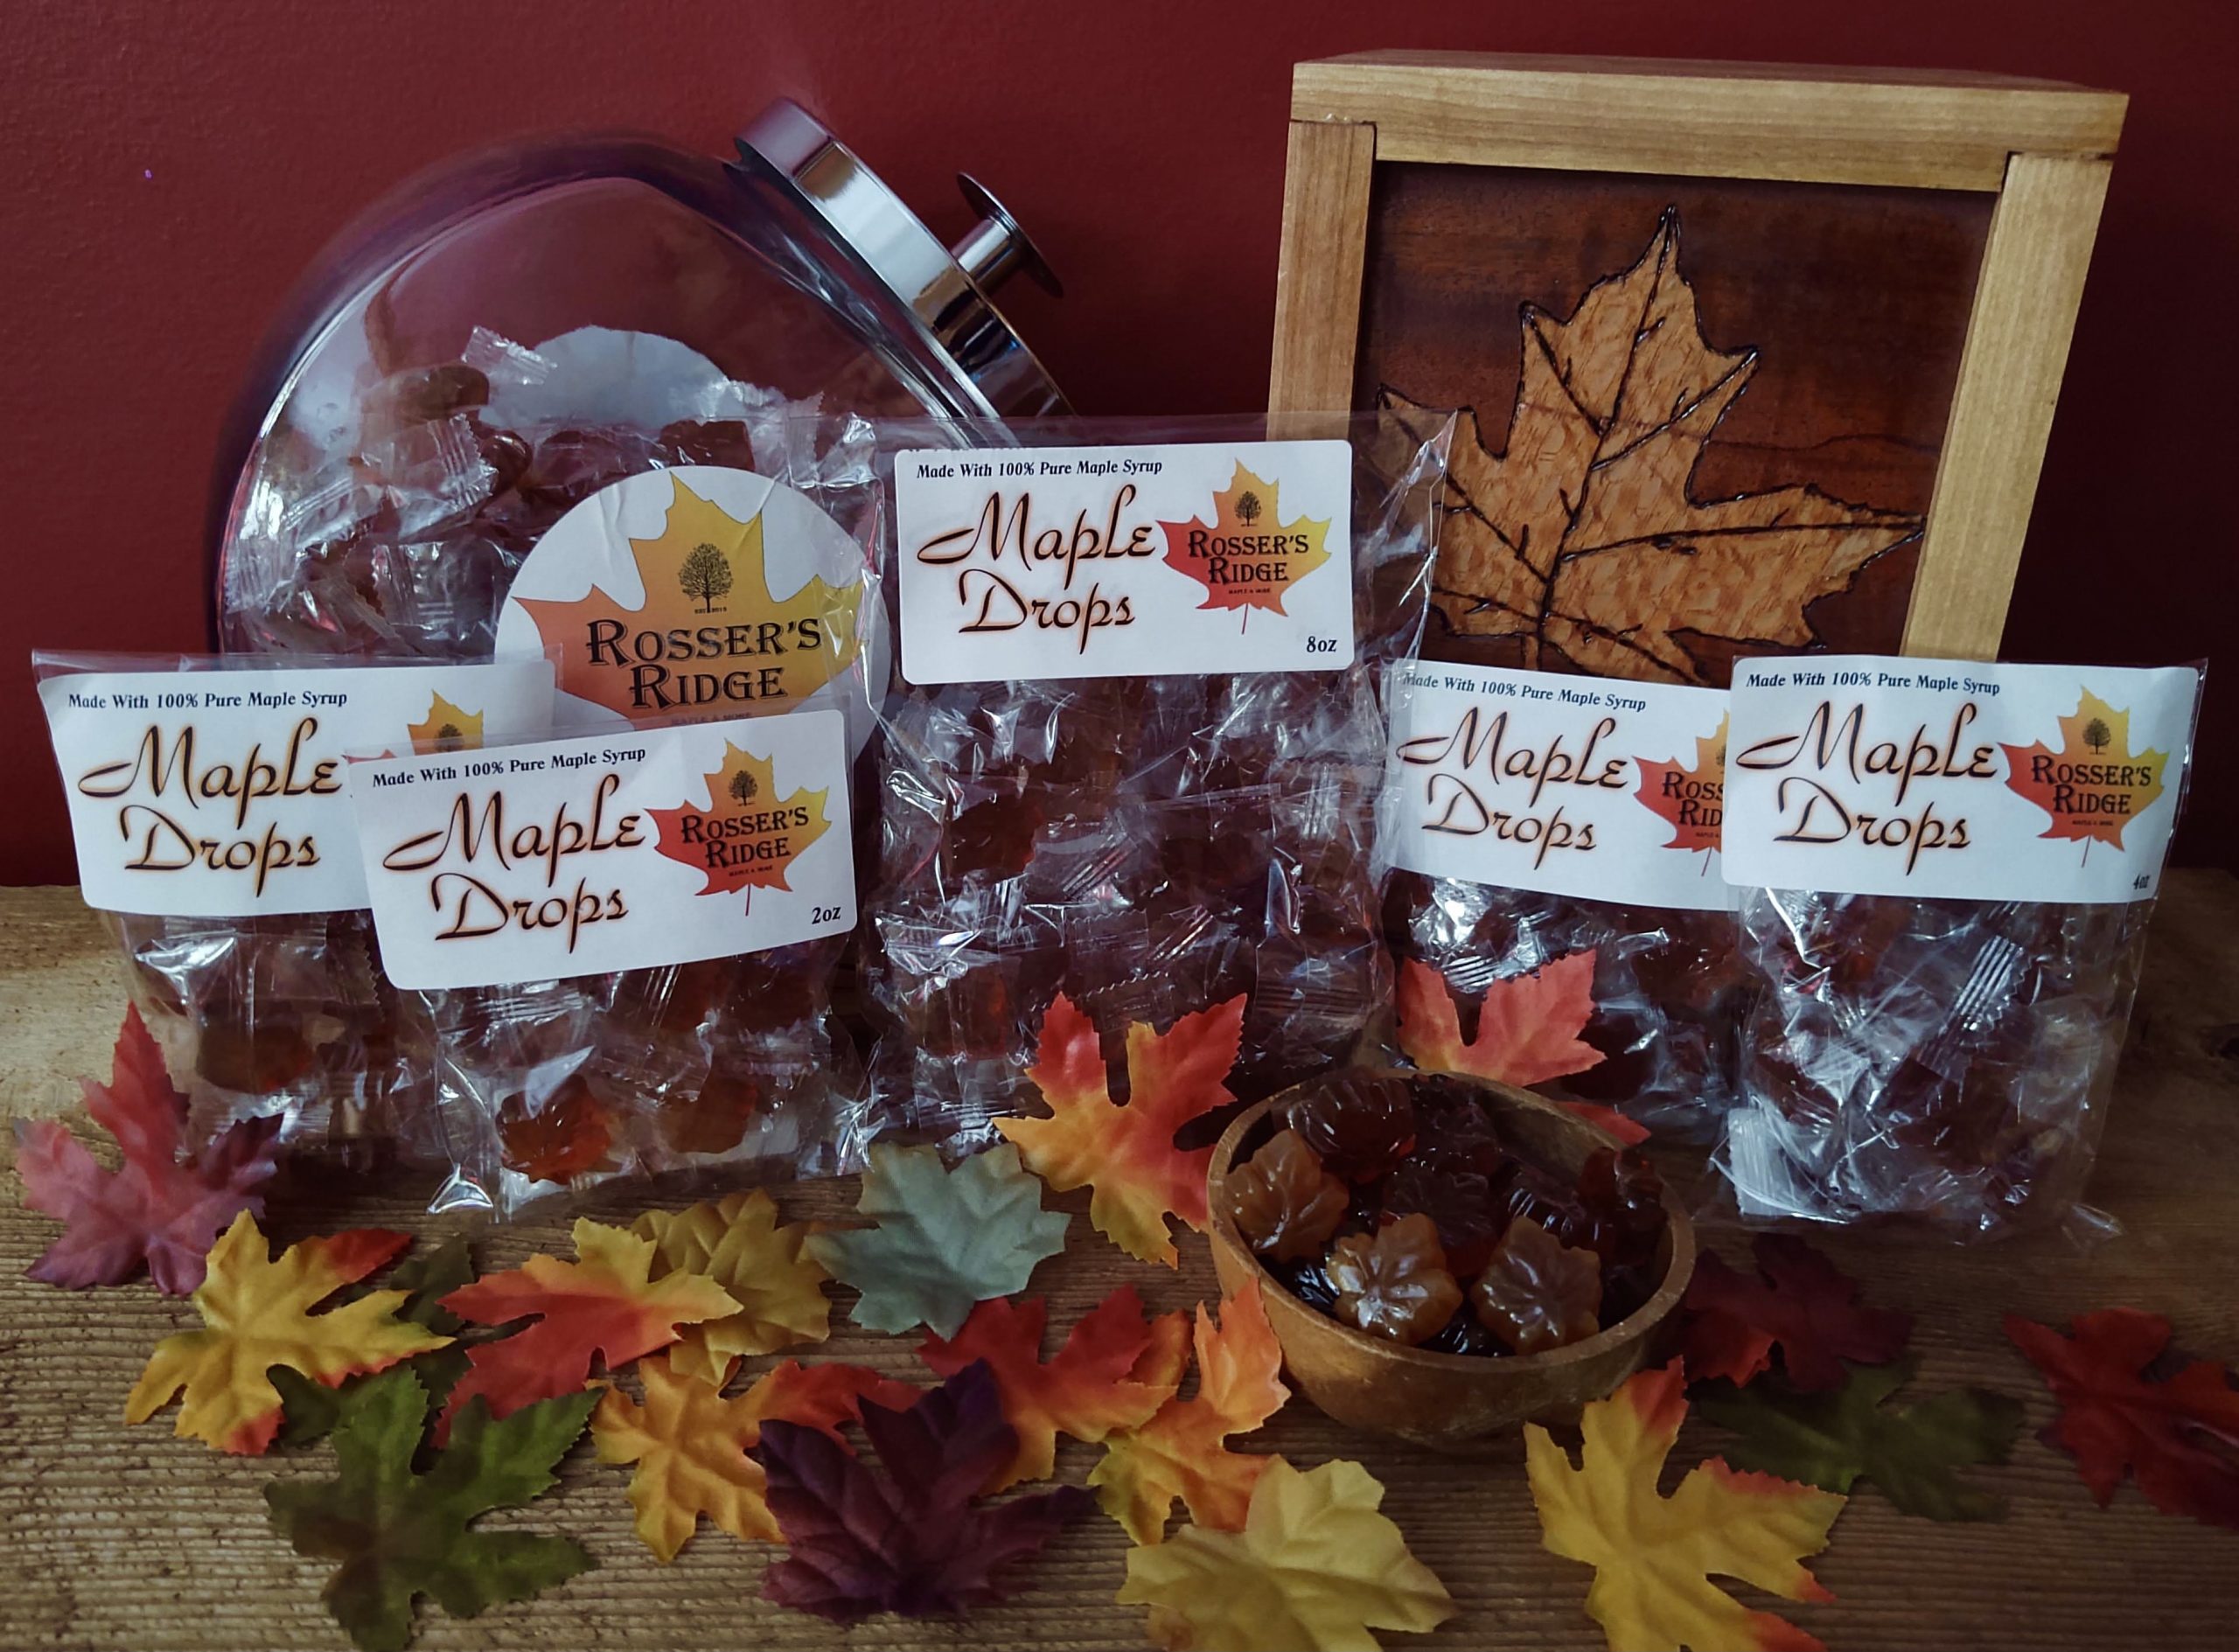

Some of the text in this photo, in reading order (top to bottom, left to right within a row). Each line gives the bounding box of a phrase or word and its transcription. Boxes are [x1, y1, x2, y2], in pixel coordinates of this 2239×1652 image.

[917, 459, 1162, 478] Made With 100% Pure Maple Syrup
[917, 484, 1157, 591] Maple
[1188, 529, 1309, 559] ROSSER'S
[1208, 556, 1289, 585] RIDGE
[958, 568, 1135, 656] Drops
[585, 617, 822, 667] ROSSER'S
[1306, 636, 1337, 654] 8oz
[69, 691, 347, 709] Made With 100% Pure Maple Syrup
[628, 664, 789, 711] RIDGE
[1403, 672, 1646, 713] Made With 100% Pure Maple Syrup
[1747, 672, 2000, 697] Made With 100% Pure Maple Syrup
[78, 716, 343, 831] Maple
[373, 749, 646, 787] Made With 100% Pure Maple Syrup
[1395, 706, 1629, 808] Maple
[1735, 701, 1999, 807] Maple
[2031, 756, 2152, 787] ROSSER'S
[1663, 770, 1724, 801] ROSS
[2052, 784, 2132, 815] RIDGE
[381, 773, 647, 889] Maple
[680, 805, 810, 844] ROSSER'S
[1421, 773, 1597, 871] Drops
[1678, 798, 1723, 827] RID
[1774, 777, 1971, 876] Drops
[119, 805, 322, 898] Drops
[704, 836, 792, 870] RIDGE
[430, 872, 630, 955] Drops
[811, 906, 841, 925] 2oz
